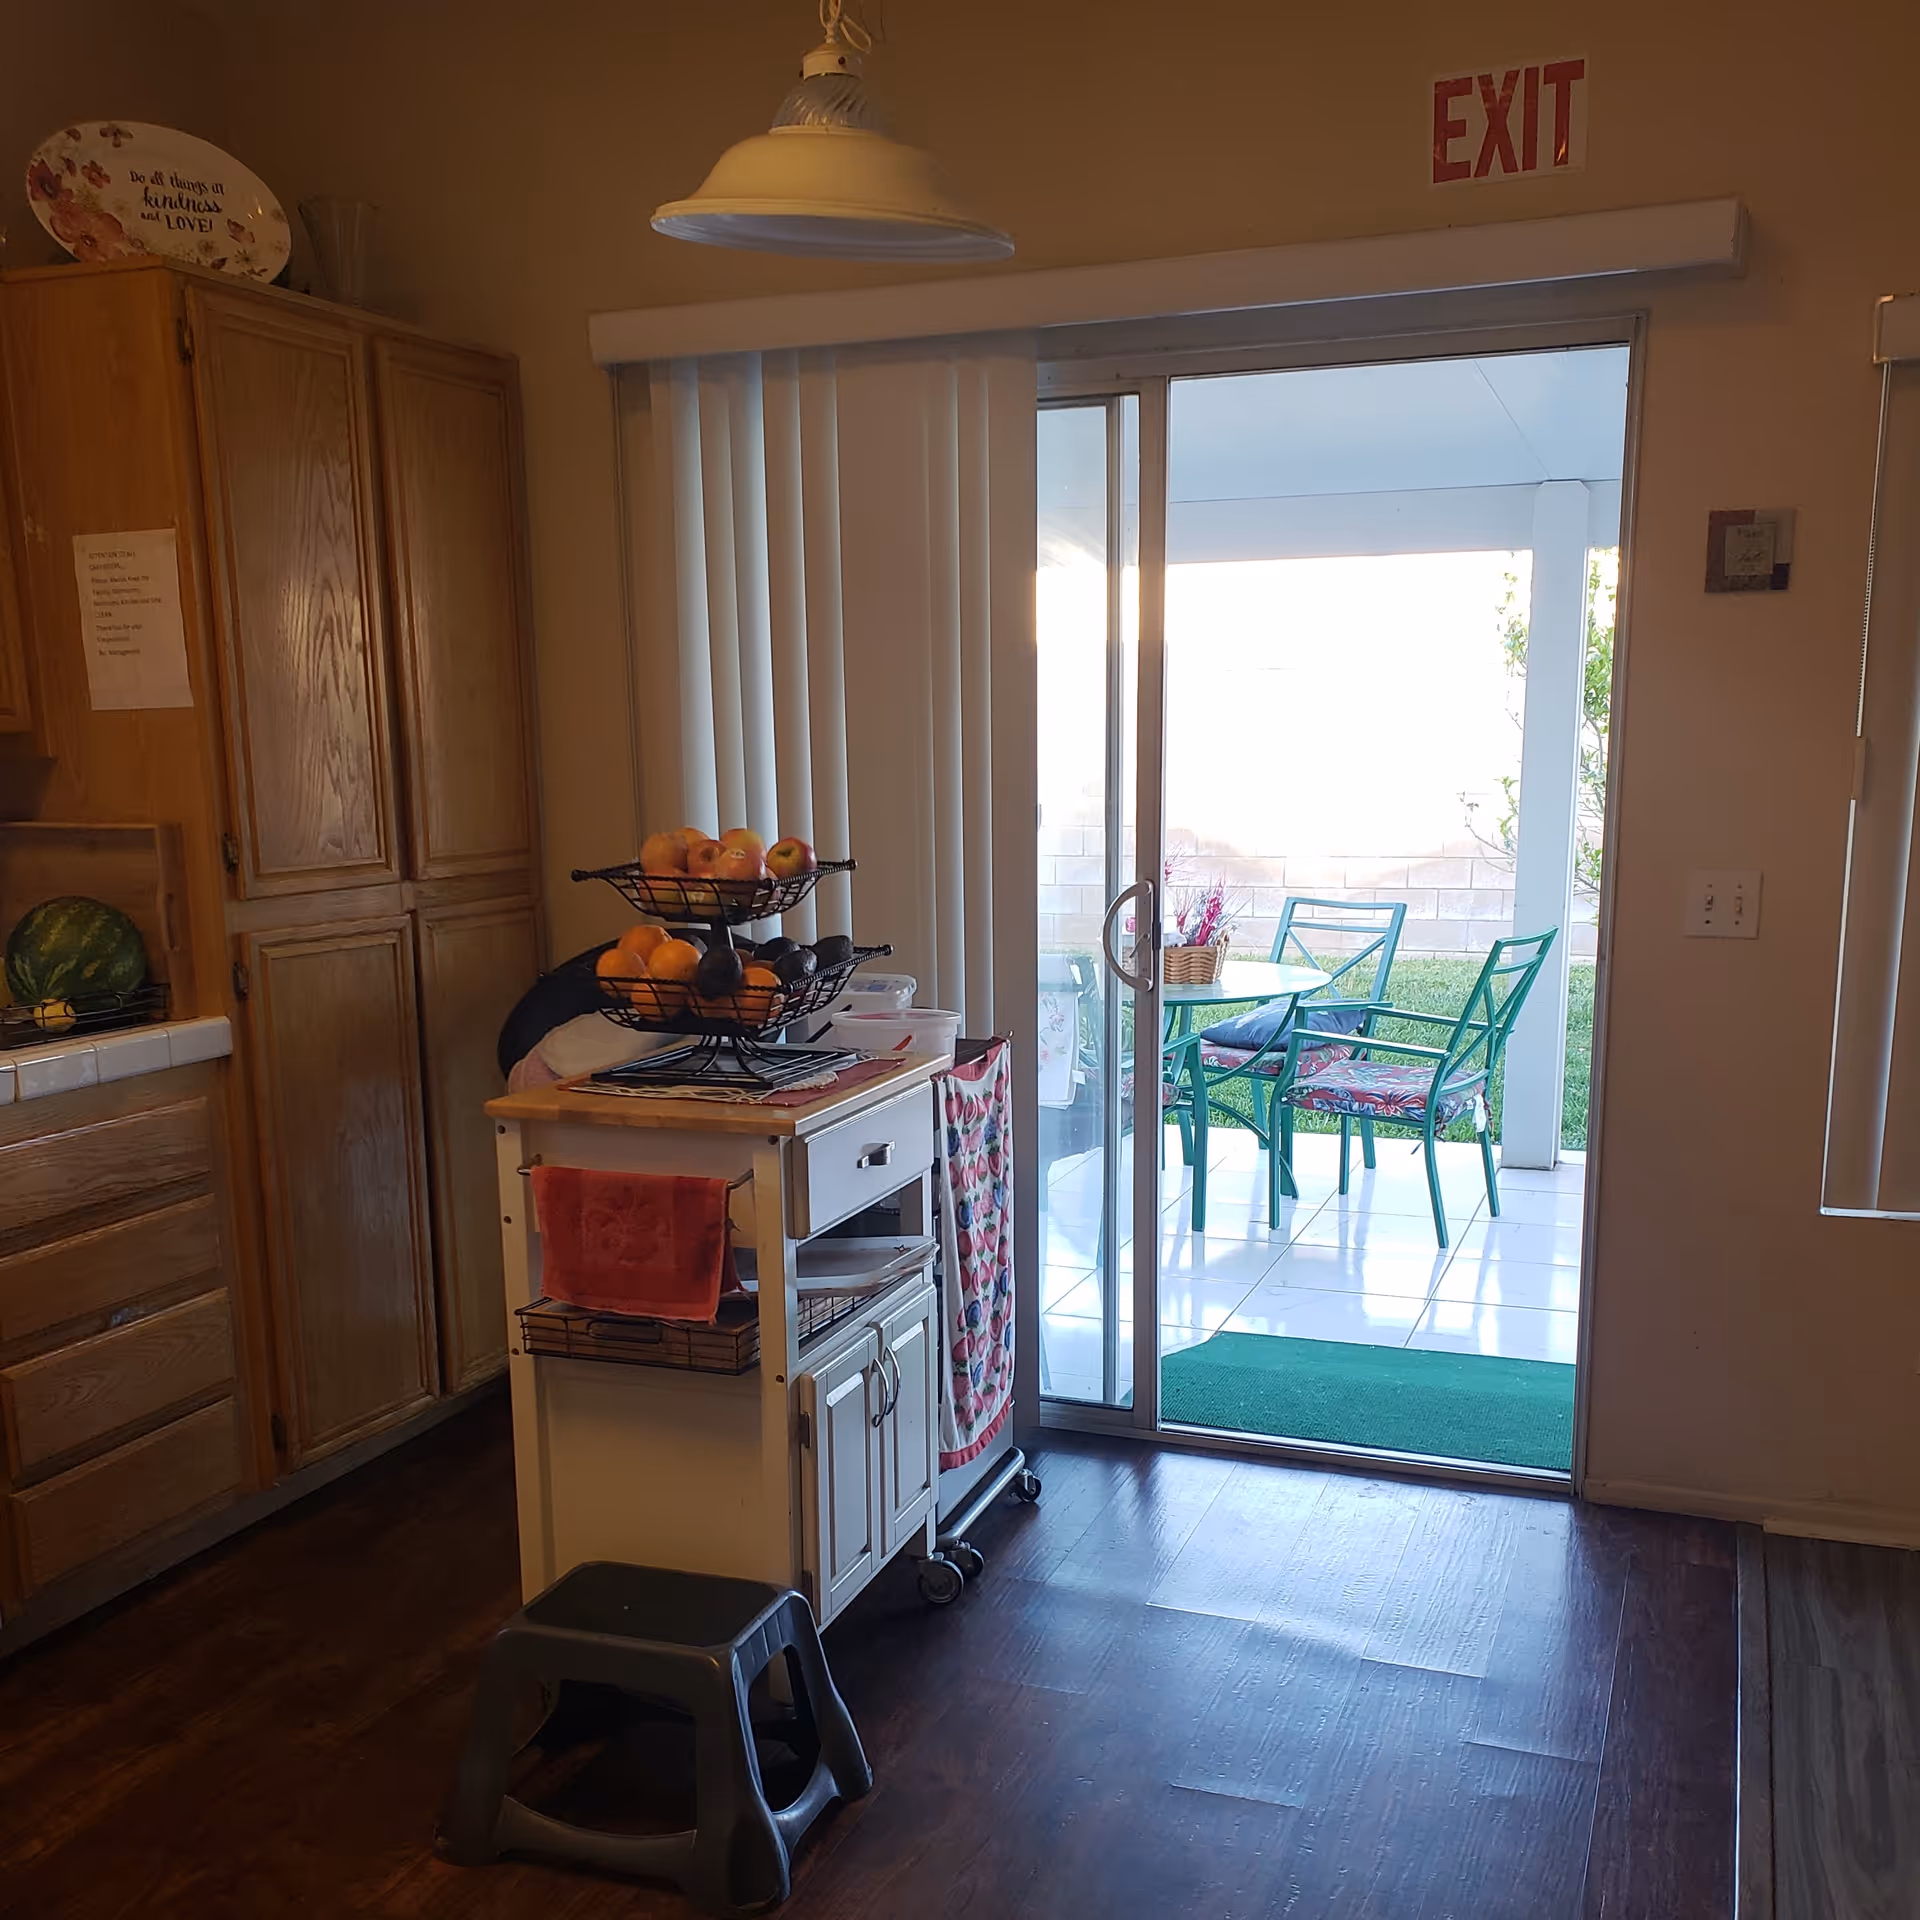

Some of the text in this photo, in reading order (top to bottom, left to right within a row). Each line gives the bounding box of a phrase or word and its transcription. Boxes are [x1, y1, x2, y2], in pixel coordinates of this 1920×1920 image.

[1433, 59, 1585, 184] EXIT
[129, 170, 145, 183] Do
[150, 170, 164, 186] all
[169, 172, 209, 196] things
[143, 186, 223, 213] kindness
[140, 211, 212, 232] and LOVE!
